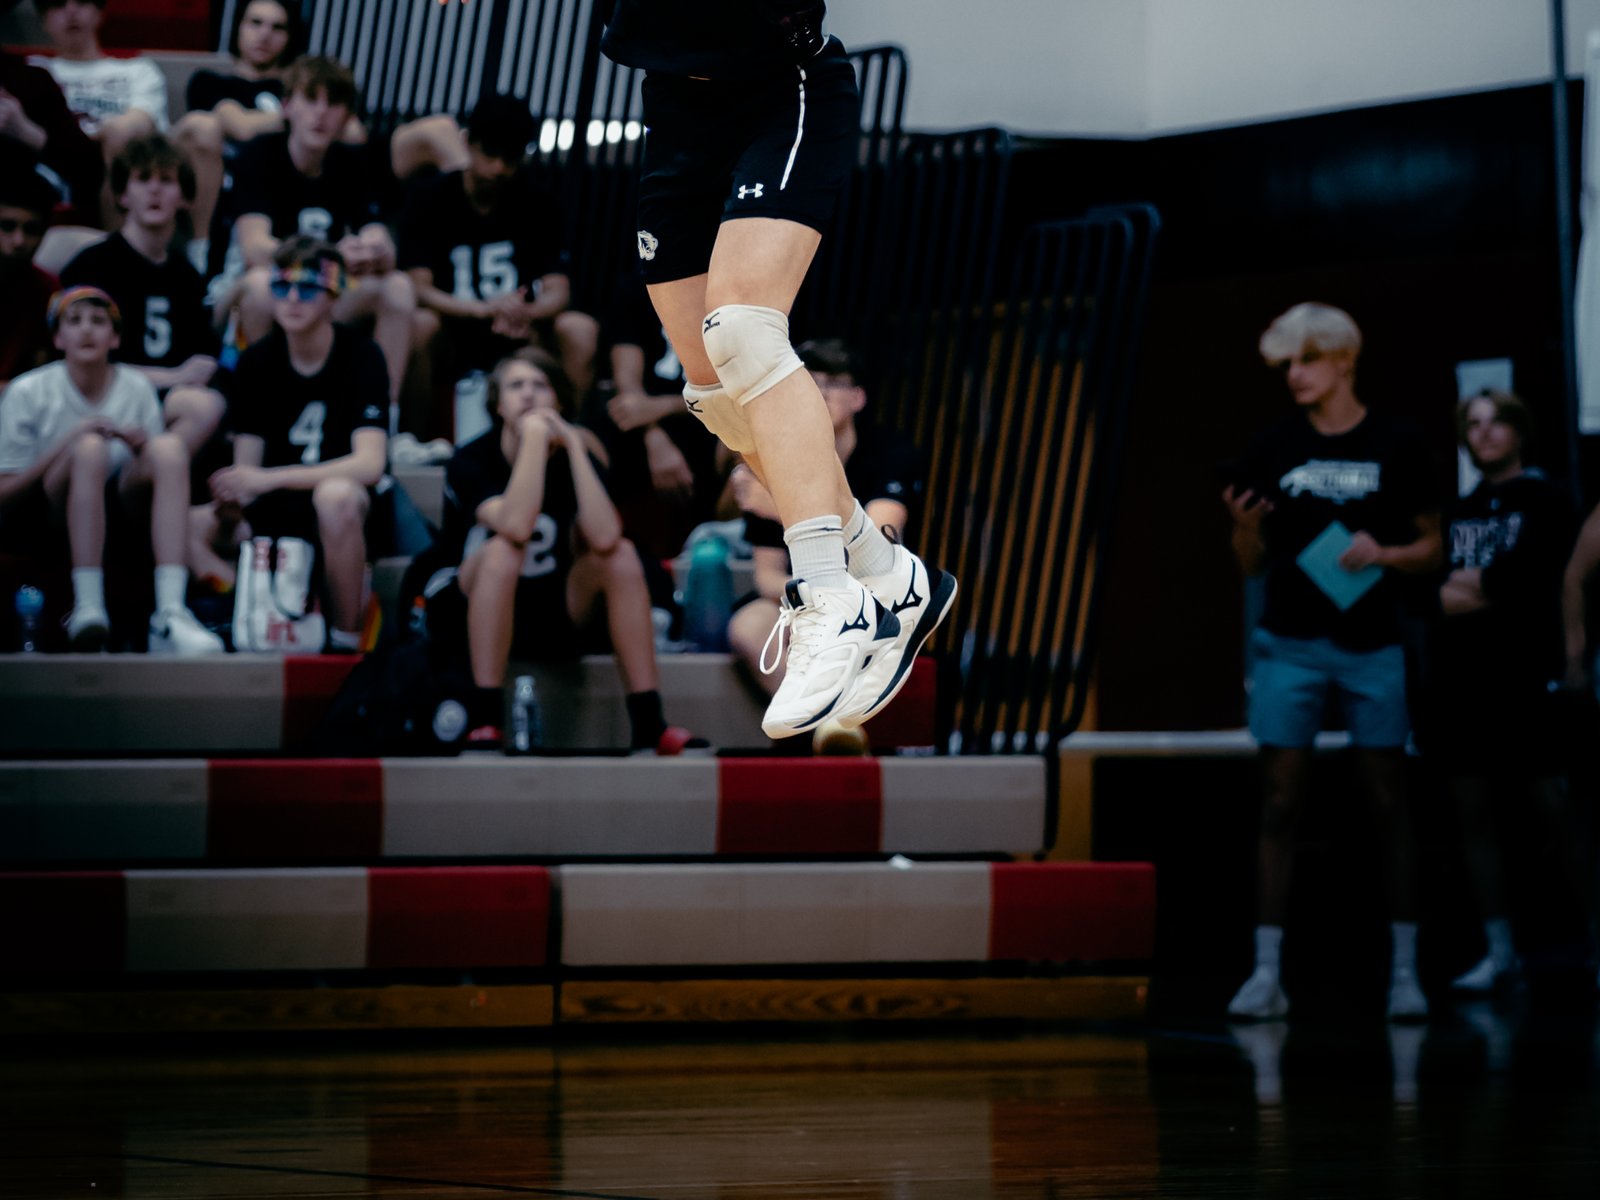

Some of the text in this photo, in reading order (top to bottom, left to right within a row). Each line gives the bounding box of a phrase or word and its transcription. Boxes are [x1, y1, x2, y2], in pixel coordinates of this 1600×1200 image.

[450, 240, 519, 301] 15
[143, 296, 173, 359] 5
[288, 400, 327, 465] 4
